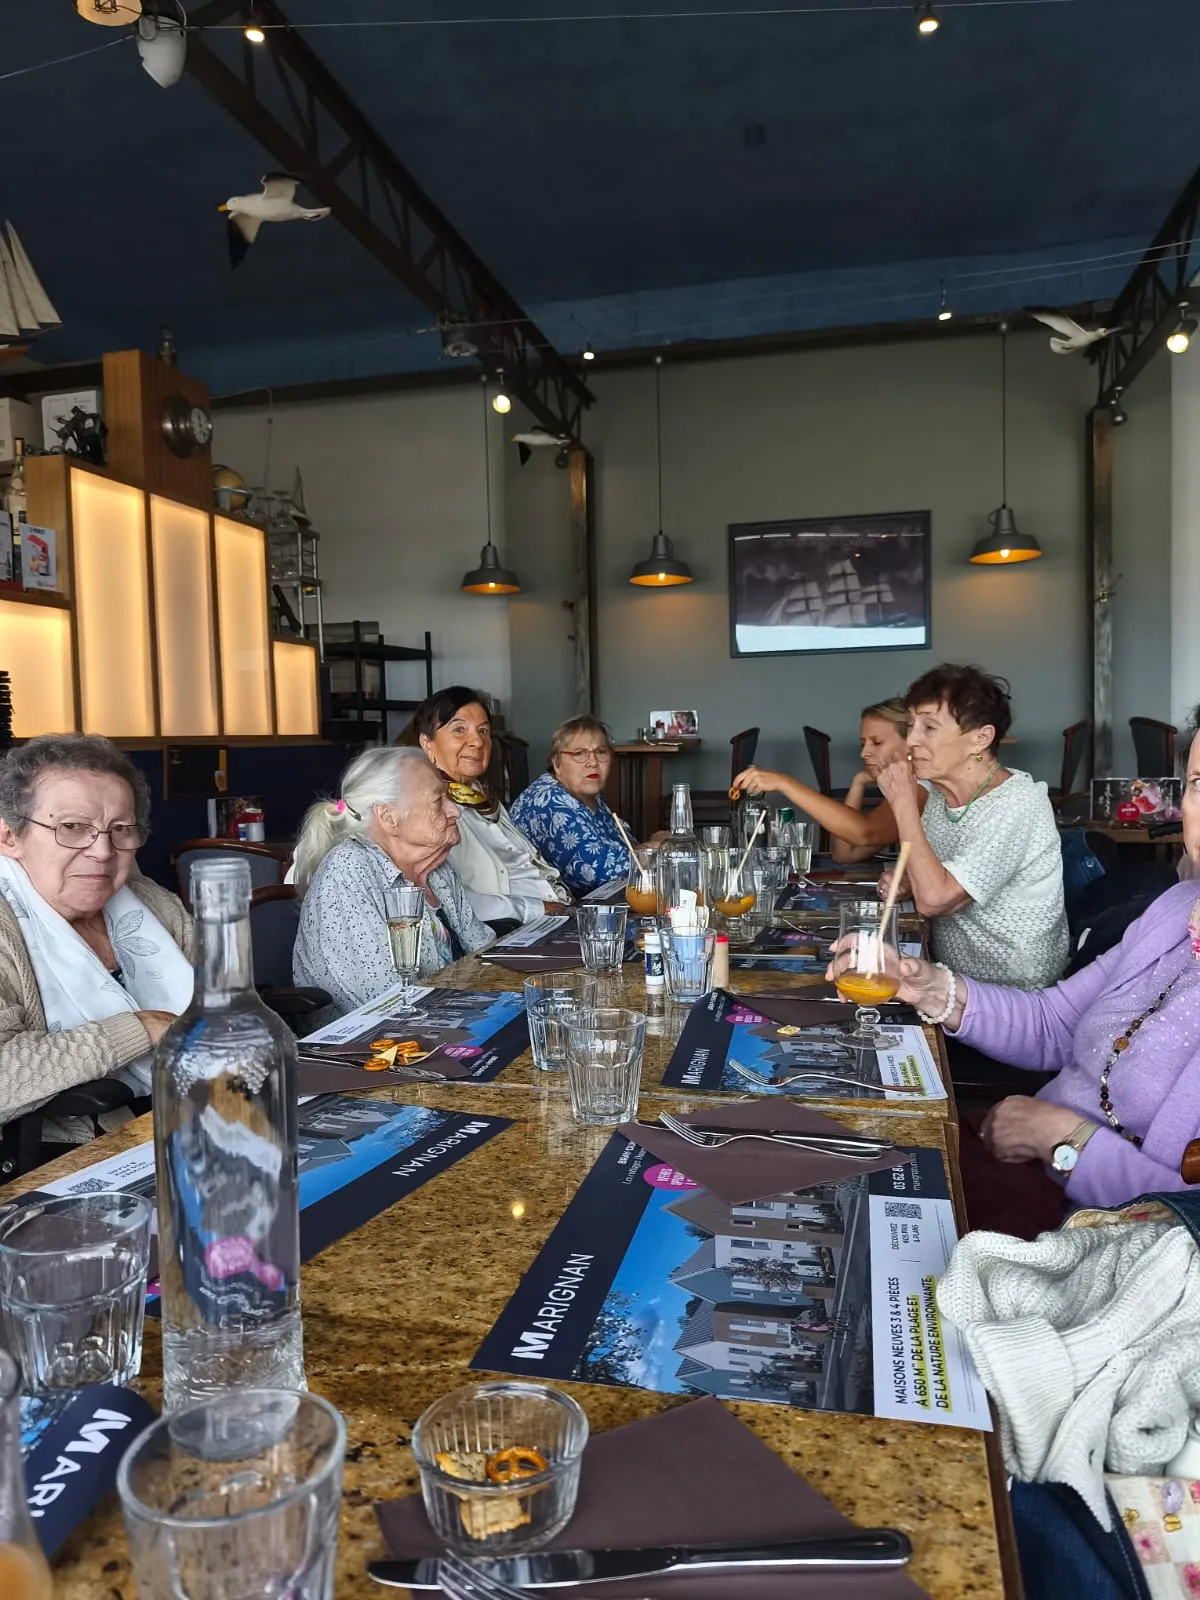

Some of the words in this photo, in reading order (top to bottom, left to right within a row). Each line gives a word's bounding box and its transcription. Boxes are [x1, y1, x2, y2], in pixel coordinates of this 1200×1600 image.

[681, 1048, 711, 1084] MARIGNAN
[392, 1121, 491, 1177] MARIGNAN
[893, 1181, 906, 1190] 03
[886, 1277, 900, 1302] PIÈCES
[906, 1296, 918, 1305] ET
[510, 1253, 595, 1360] MARIGNAN
[921, 1278, 939, 1337] ENVIRONNANTE
[907, 1308, 920, 1333] PLAGE
[891, 1324, 904, 1357] NEUVES
[910, 1336, 921, 1347] LA
[911, 1348, 923, 1361] DE
[928, 1340, 945, 1376] NATURE
[893, 1360, 908, 1404] MAISONS
[914, 1379, 927, 1396] 650
[933, 1379, 946, 1391] LA
[912, 1399, 928, 1407] À
[935, 1394, 949, 1408] DE
